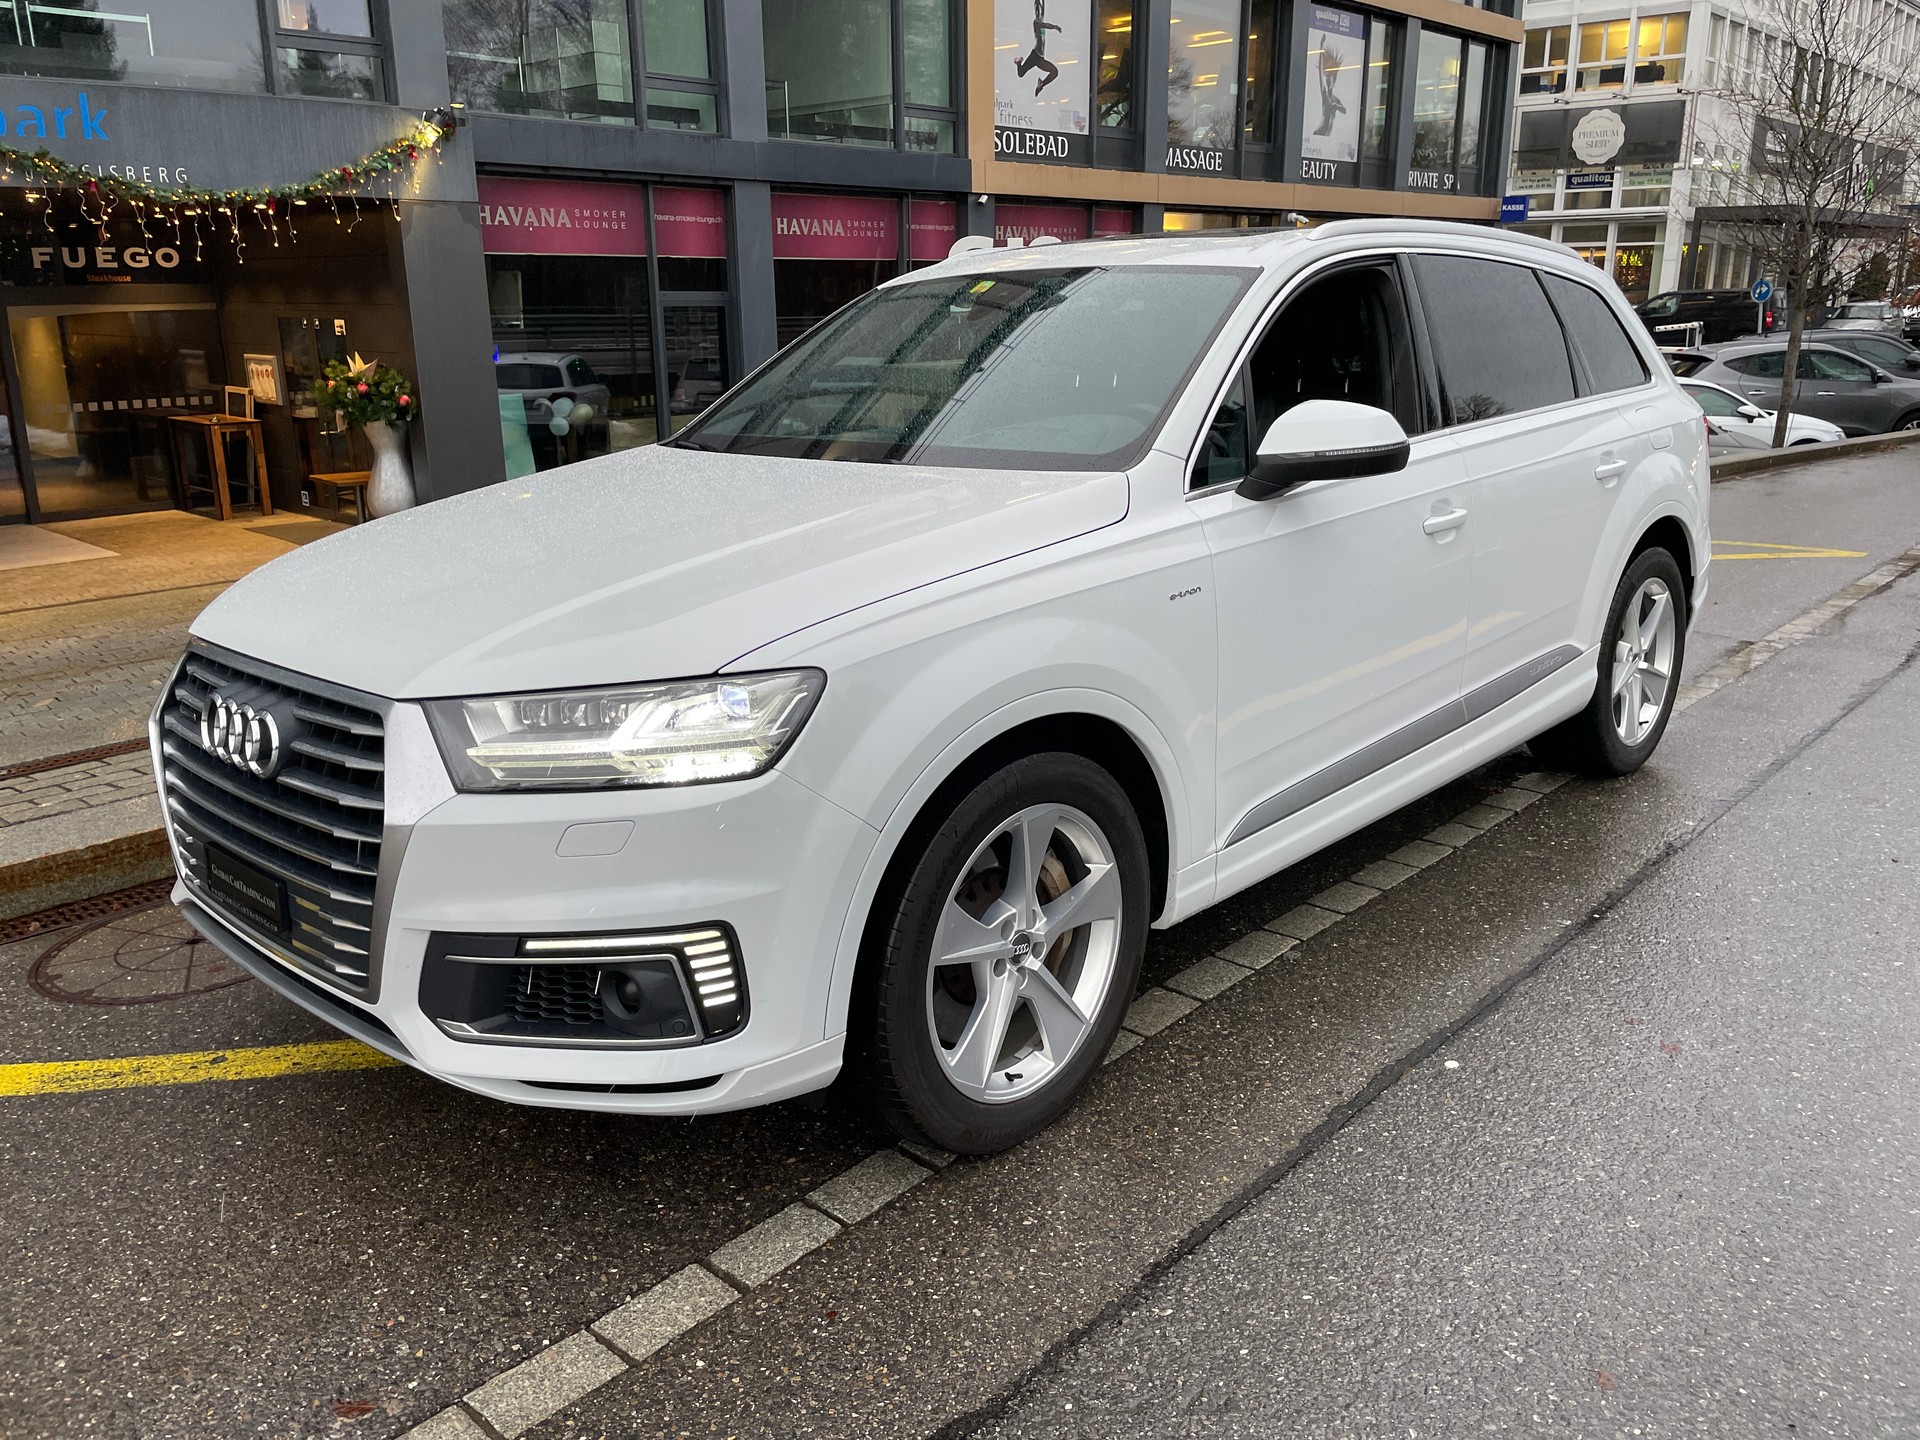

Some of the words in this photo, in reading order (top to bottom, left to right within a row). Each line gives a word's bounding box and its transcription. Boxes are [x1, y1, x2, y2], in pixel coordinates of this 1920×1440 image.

[0, 92, 110, 141] ark
[1000, 109, 1033, 127] fitness
[1578, 129, 1619, 140] PREMIUM
[994, 130, 1069, 158] SOLEBAD
[1300, 160, 1337, 180] EAUTY
[1571, 173, 1611, 185] qualitop
[478, 205, 572, 228] HAVANA
[575, 208, 627, 219] SMOKER
[575, 220, 627, 230] LOUNGE
[776, 217, 845, 237] HAVANA
[846, 220, 885, 229] SMOKER
[847, 230, 885, 239] LOUNGE
[995, 225, 1046, 241] HAVANA
[31, 247, 180, 268] FUEGO
[86, 274, 132, 283] Steakhouse
[1169, 586, 1202, 601] e-tron
